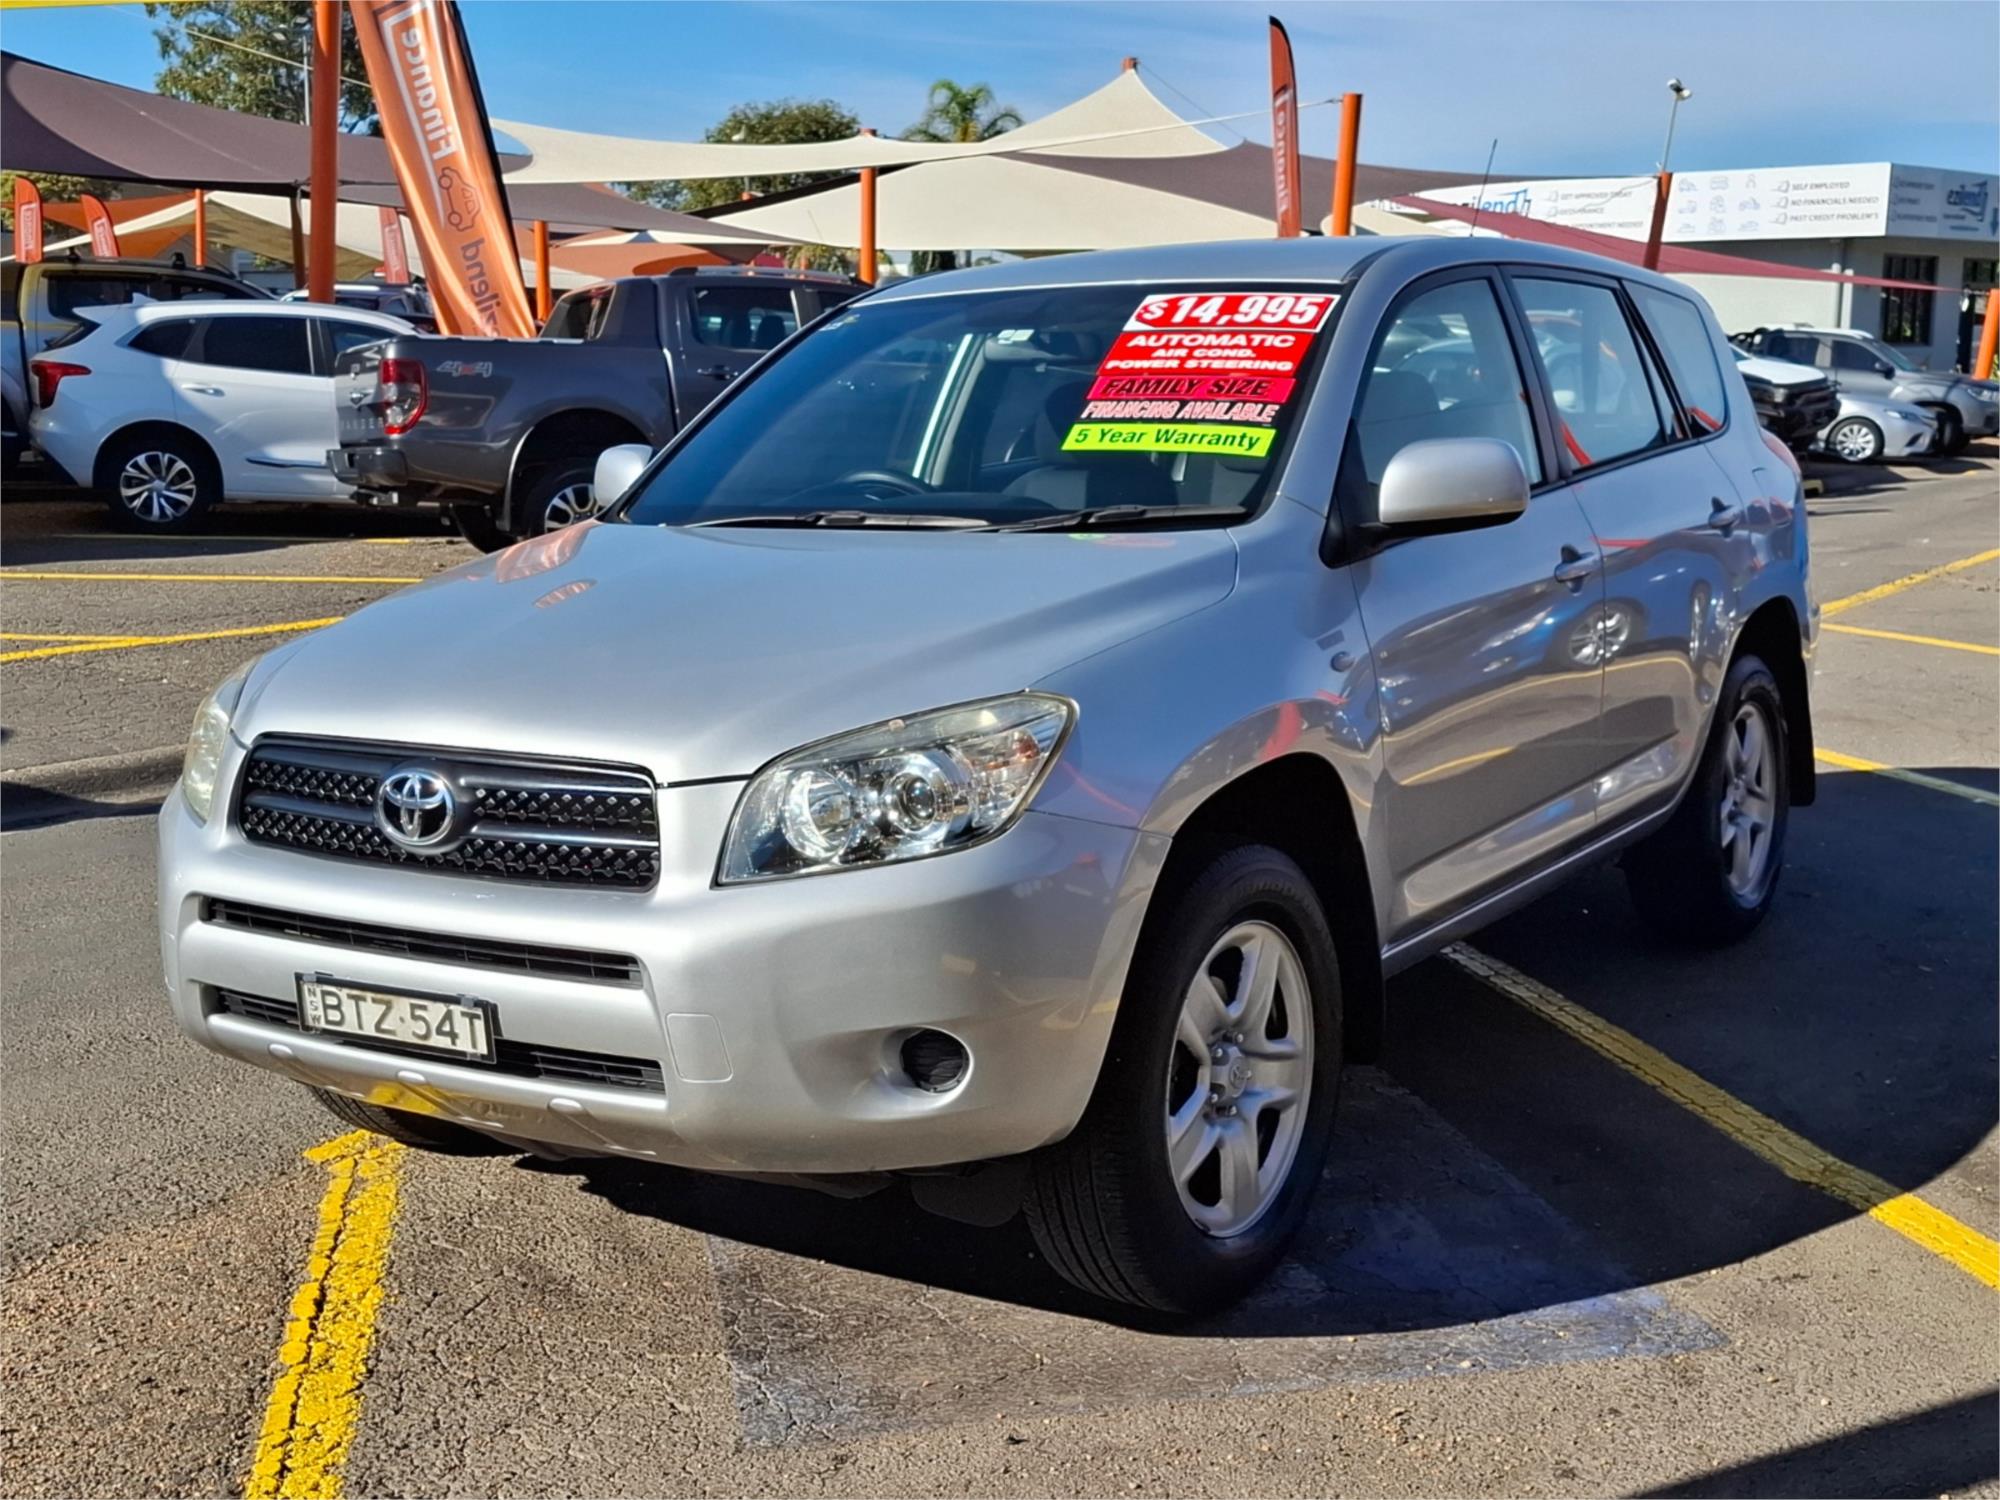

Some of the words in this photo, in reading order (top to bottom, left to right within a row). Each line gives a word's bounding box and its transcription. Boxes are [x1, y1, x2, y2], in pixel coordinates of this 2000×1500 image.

[1809, 181, 1850, 190] EMPLOYED
[1126, 334, 1296, 348] AUTOMATIC
[1152, 349, 1190, 358] AIR
[1192, 349, 1257, 358] COND.
[1105, 359, 1178, 370] POWER
[1183, 360, 1293, 371] STEERING
[1102, 378, 1201, 395] FAMILY
[1207, 378, 1272, 396] SIZE
[1081, 400, 1178, 420] FINANCING
[1176, 401, 1281, 423] AVAILABLE
[1074, 429, 1088, 443] 5
[1098, 429, 1147, 444] Year
[1154, 428, 1261, 451] Warranty
